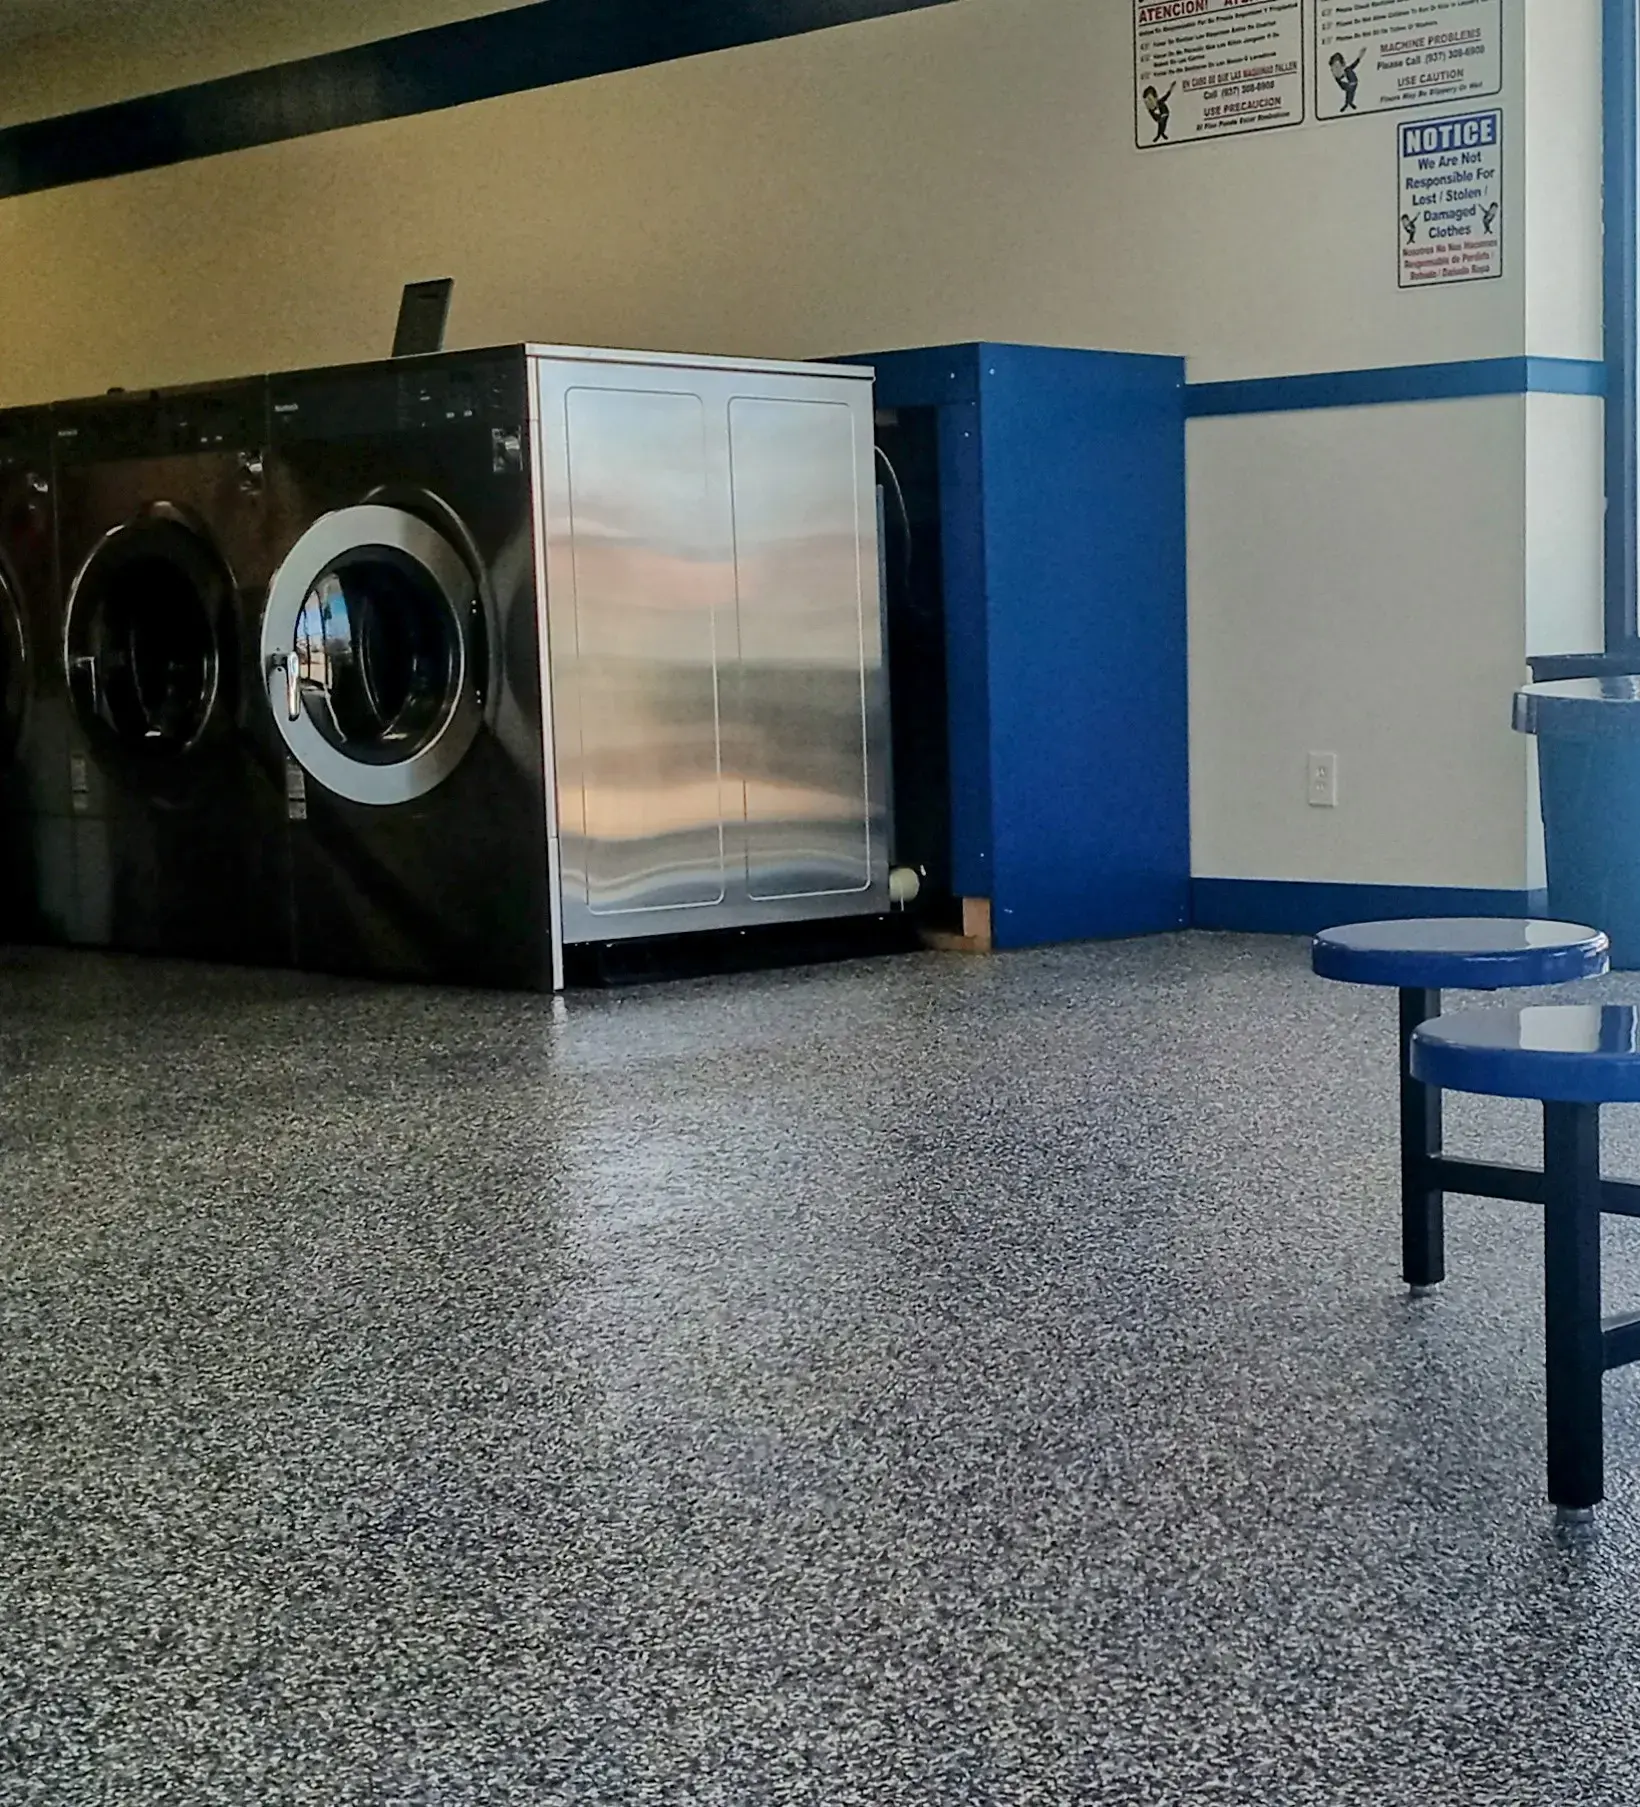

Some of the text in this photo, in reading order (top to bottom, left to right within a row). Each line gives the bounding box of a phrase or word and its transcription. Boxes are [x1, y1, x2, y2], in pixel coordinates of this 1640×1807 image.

[1380, 28, 1481, 53] MACHINE PROBLEMS
[1377, 60, 1403, 70] Please
[1405, 55, 1421, 66] Call
[1397, 68, 1464, 87] USE CAUTION
[1406, 118, 1493, 154] NOTICE
[1418, 151, 1482, 170] We Are Not
[1406, 168, 1495, 190] Responsible For
[1412, 193, 1437, 207] Lost
[1445, 188, 1482, 202] Stolen
[1423, 204, 1476, 222] Damaged
[1428, 224, 1472, 239] Clothes
